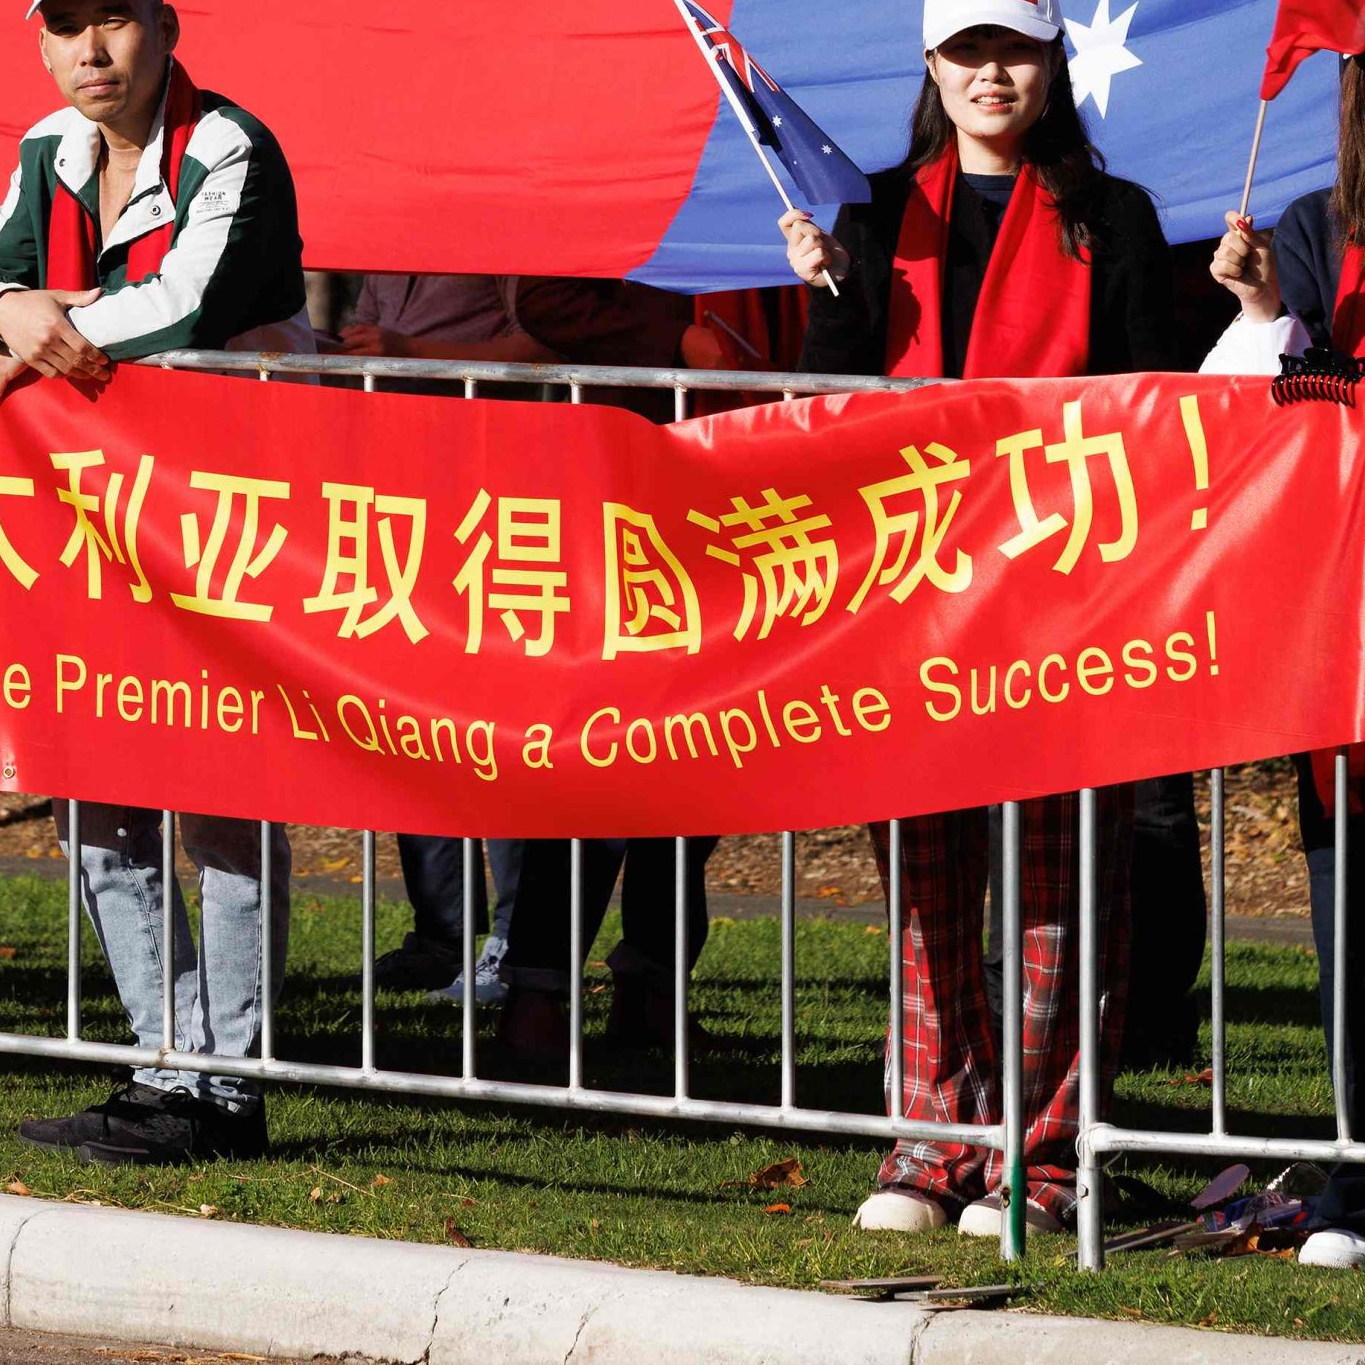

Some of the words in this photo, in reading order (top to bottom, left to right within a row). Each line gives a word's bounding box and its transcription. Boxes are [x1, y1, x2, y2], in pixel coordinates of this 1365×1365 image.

[56, 653, 265, 735] Premier
[278, 684, 330, 743] Li
[336, 694, 498, 782] Qiang
[522, 723, 555, 770] a
[580, 683, 892, 770] Complete
[919, 609, 1220, 723] Success!
